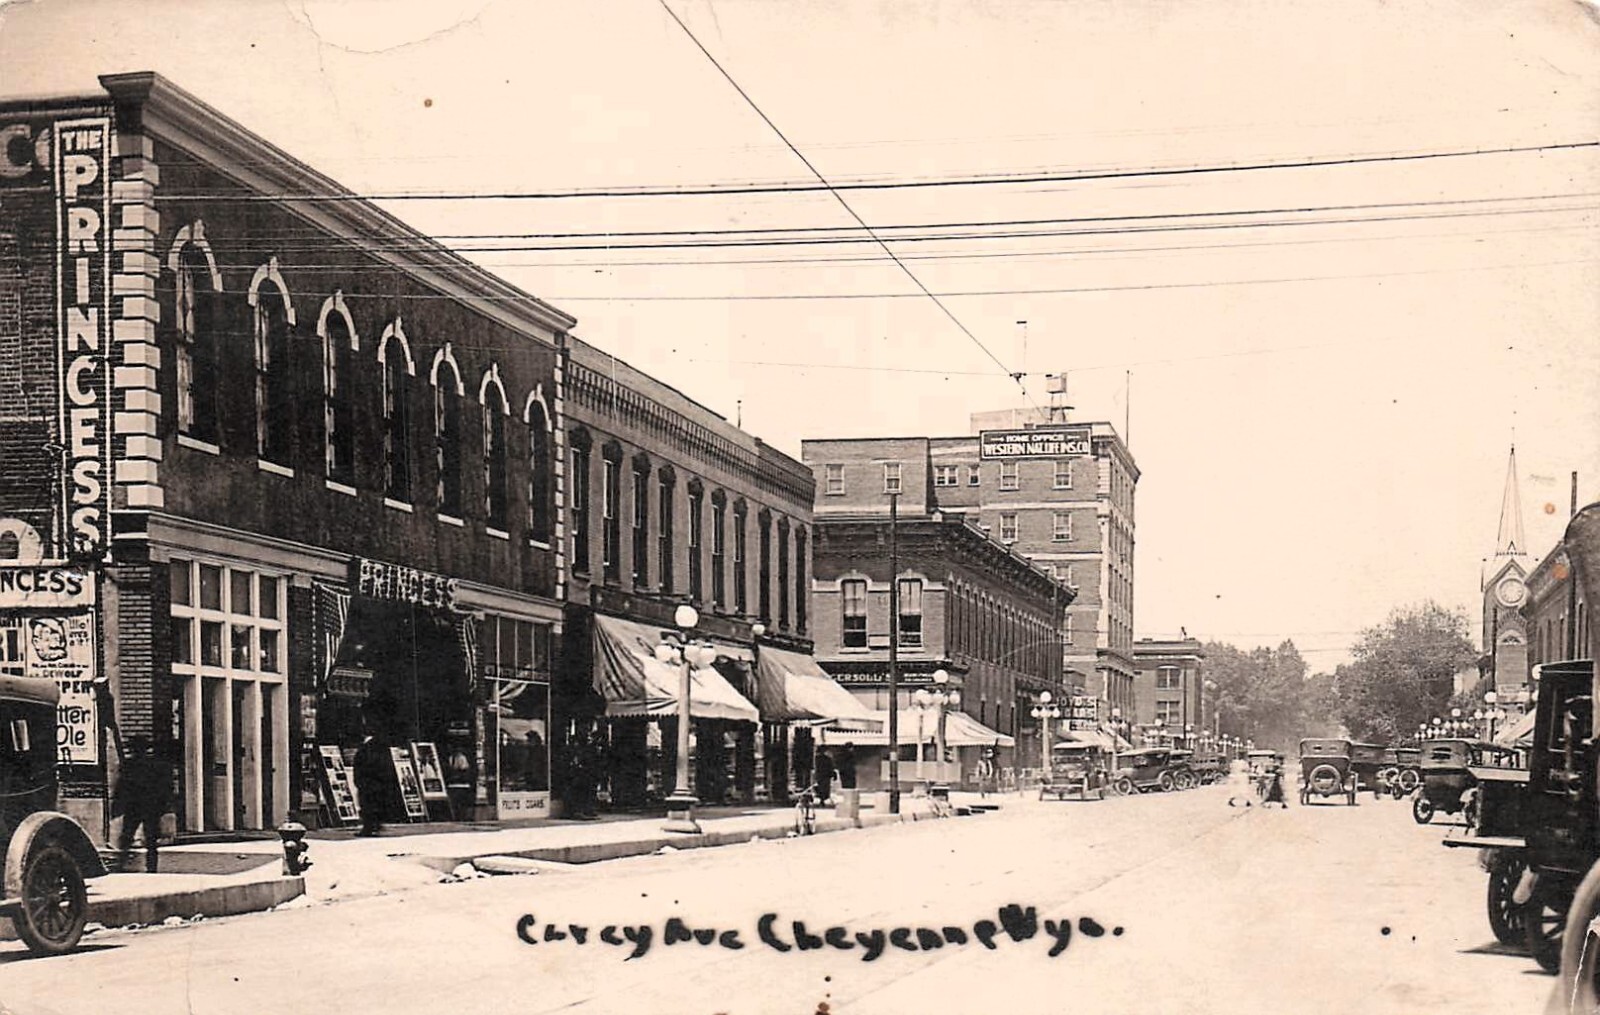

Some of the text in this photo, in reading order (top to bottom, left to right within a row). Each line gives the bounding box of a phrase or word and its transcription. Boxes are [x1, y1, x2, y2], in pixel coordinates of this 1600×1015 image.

[61, 130, 102, 151] THE
[63, 153, 102, 551] PRINCESS
[983, 442, 1025, 455] WESTERN
